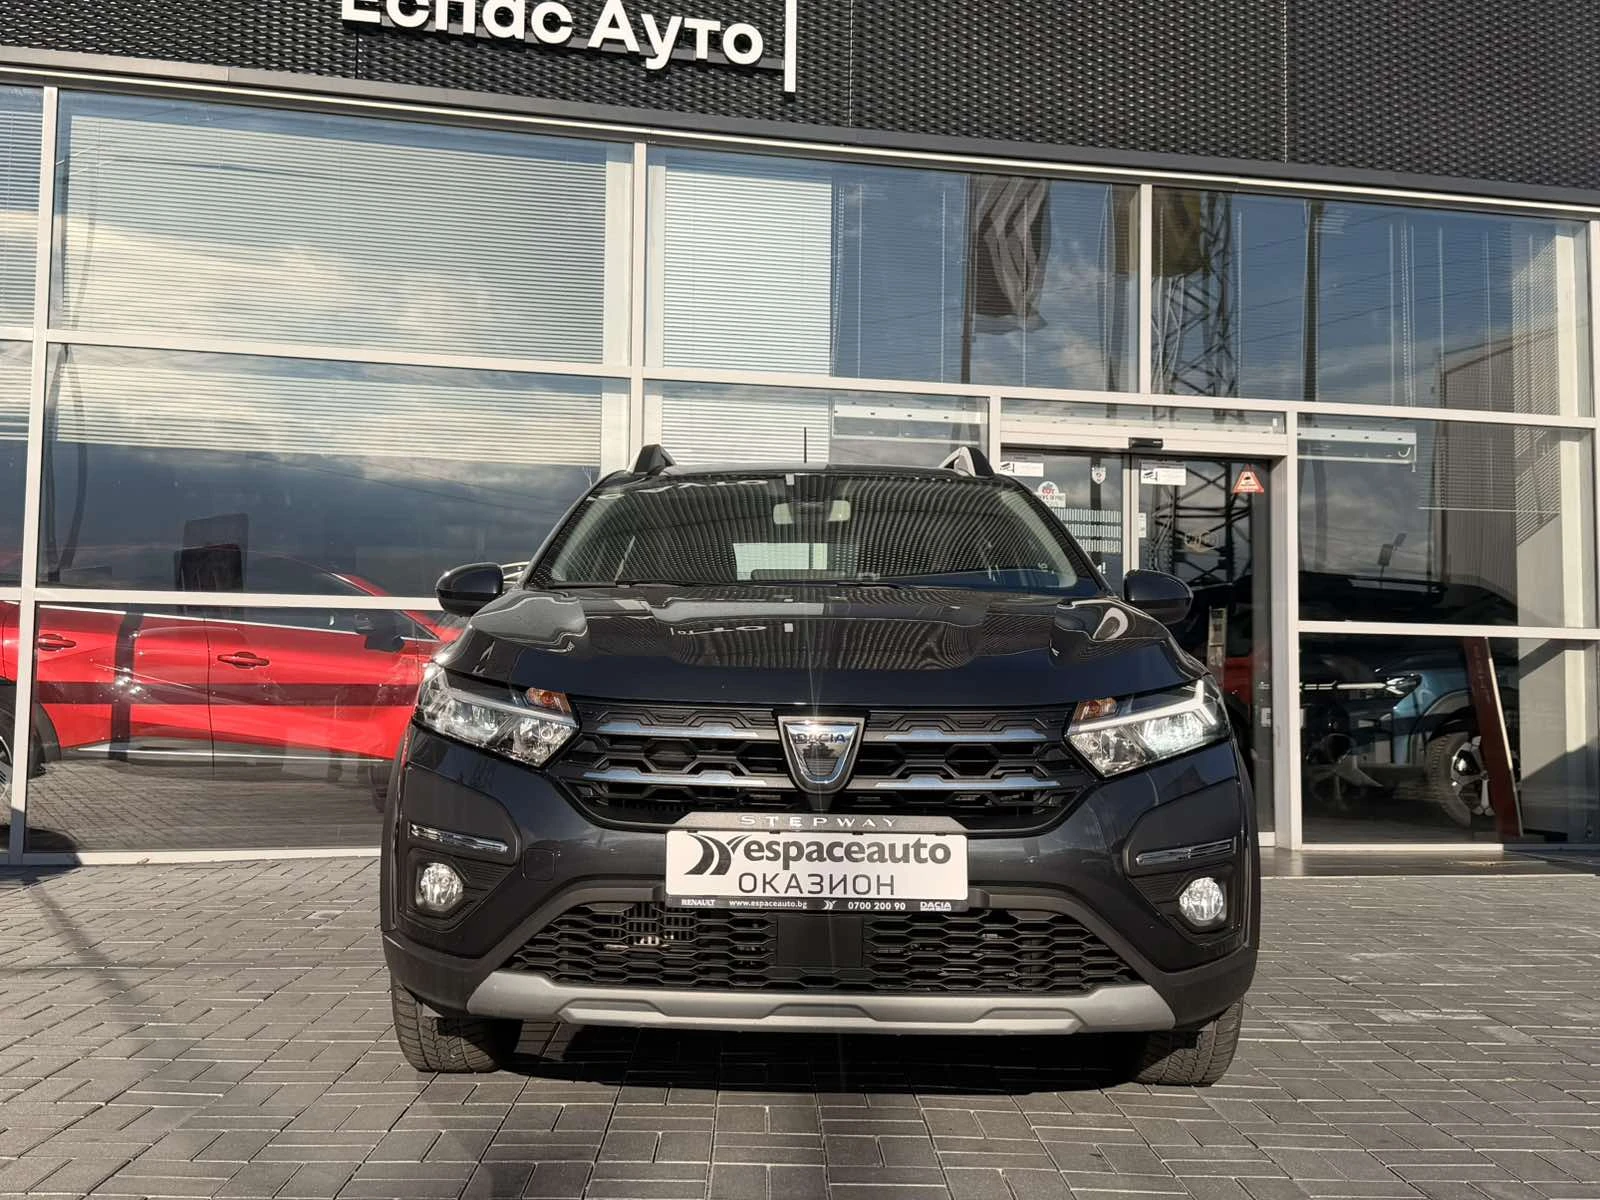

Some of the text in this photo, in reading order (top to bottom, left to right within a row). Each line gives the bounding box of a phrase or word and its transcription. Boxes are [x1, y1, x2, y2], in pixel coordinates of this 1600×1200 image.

[587, 0, 764, 71] Ауто
[795, 733, 846, 744] DACIA
[741, 815, 896, 827] STEPWAY
[743, 837, 952, 871] espaceauto
[738, 872, 895, 896] ОКАЗИОН
[681, 898, 952, 911] RENAULT www.espaceauto.bg 0700 200 90 DACIA
